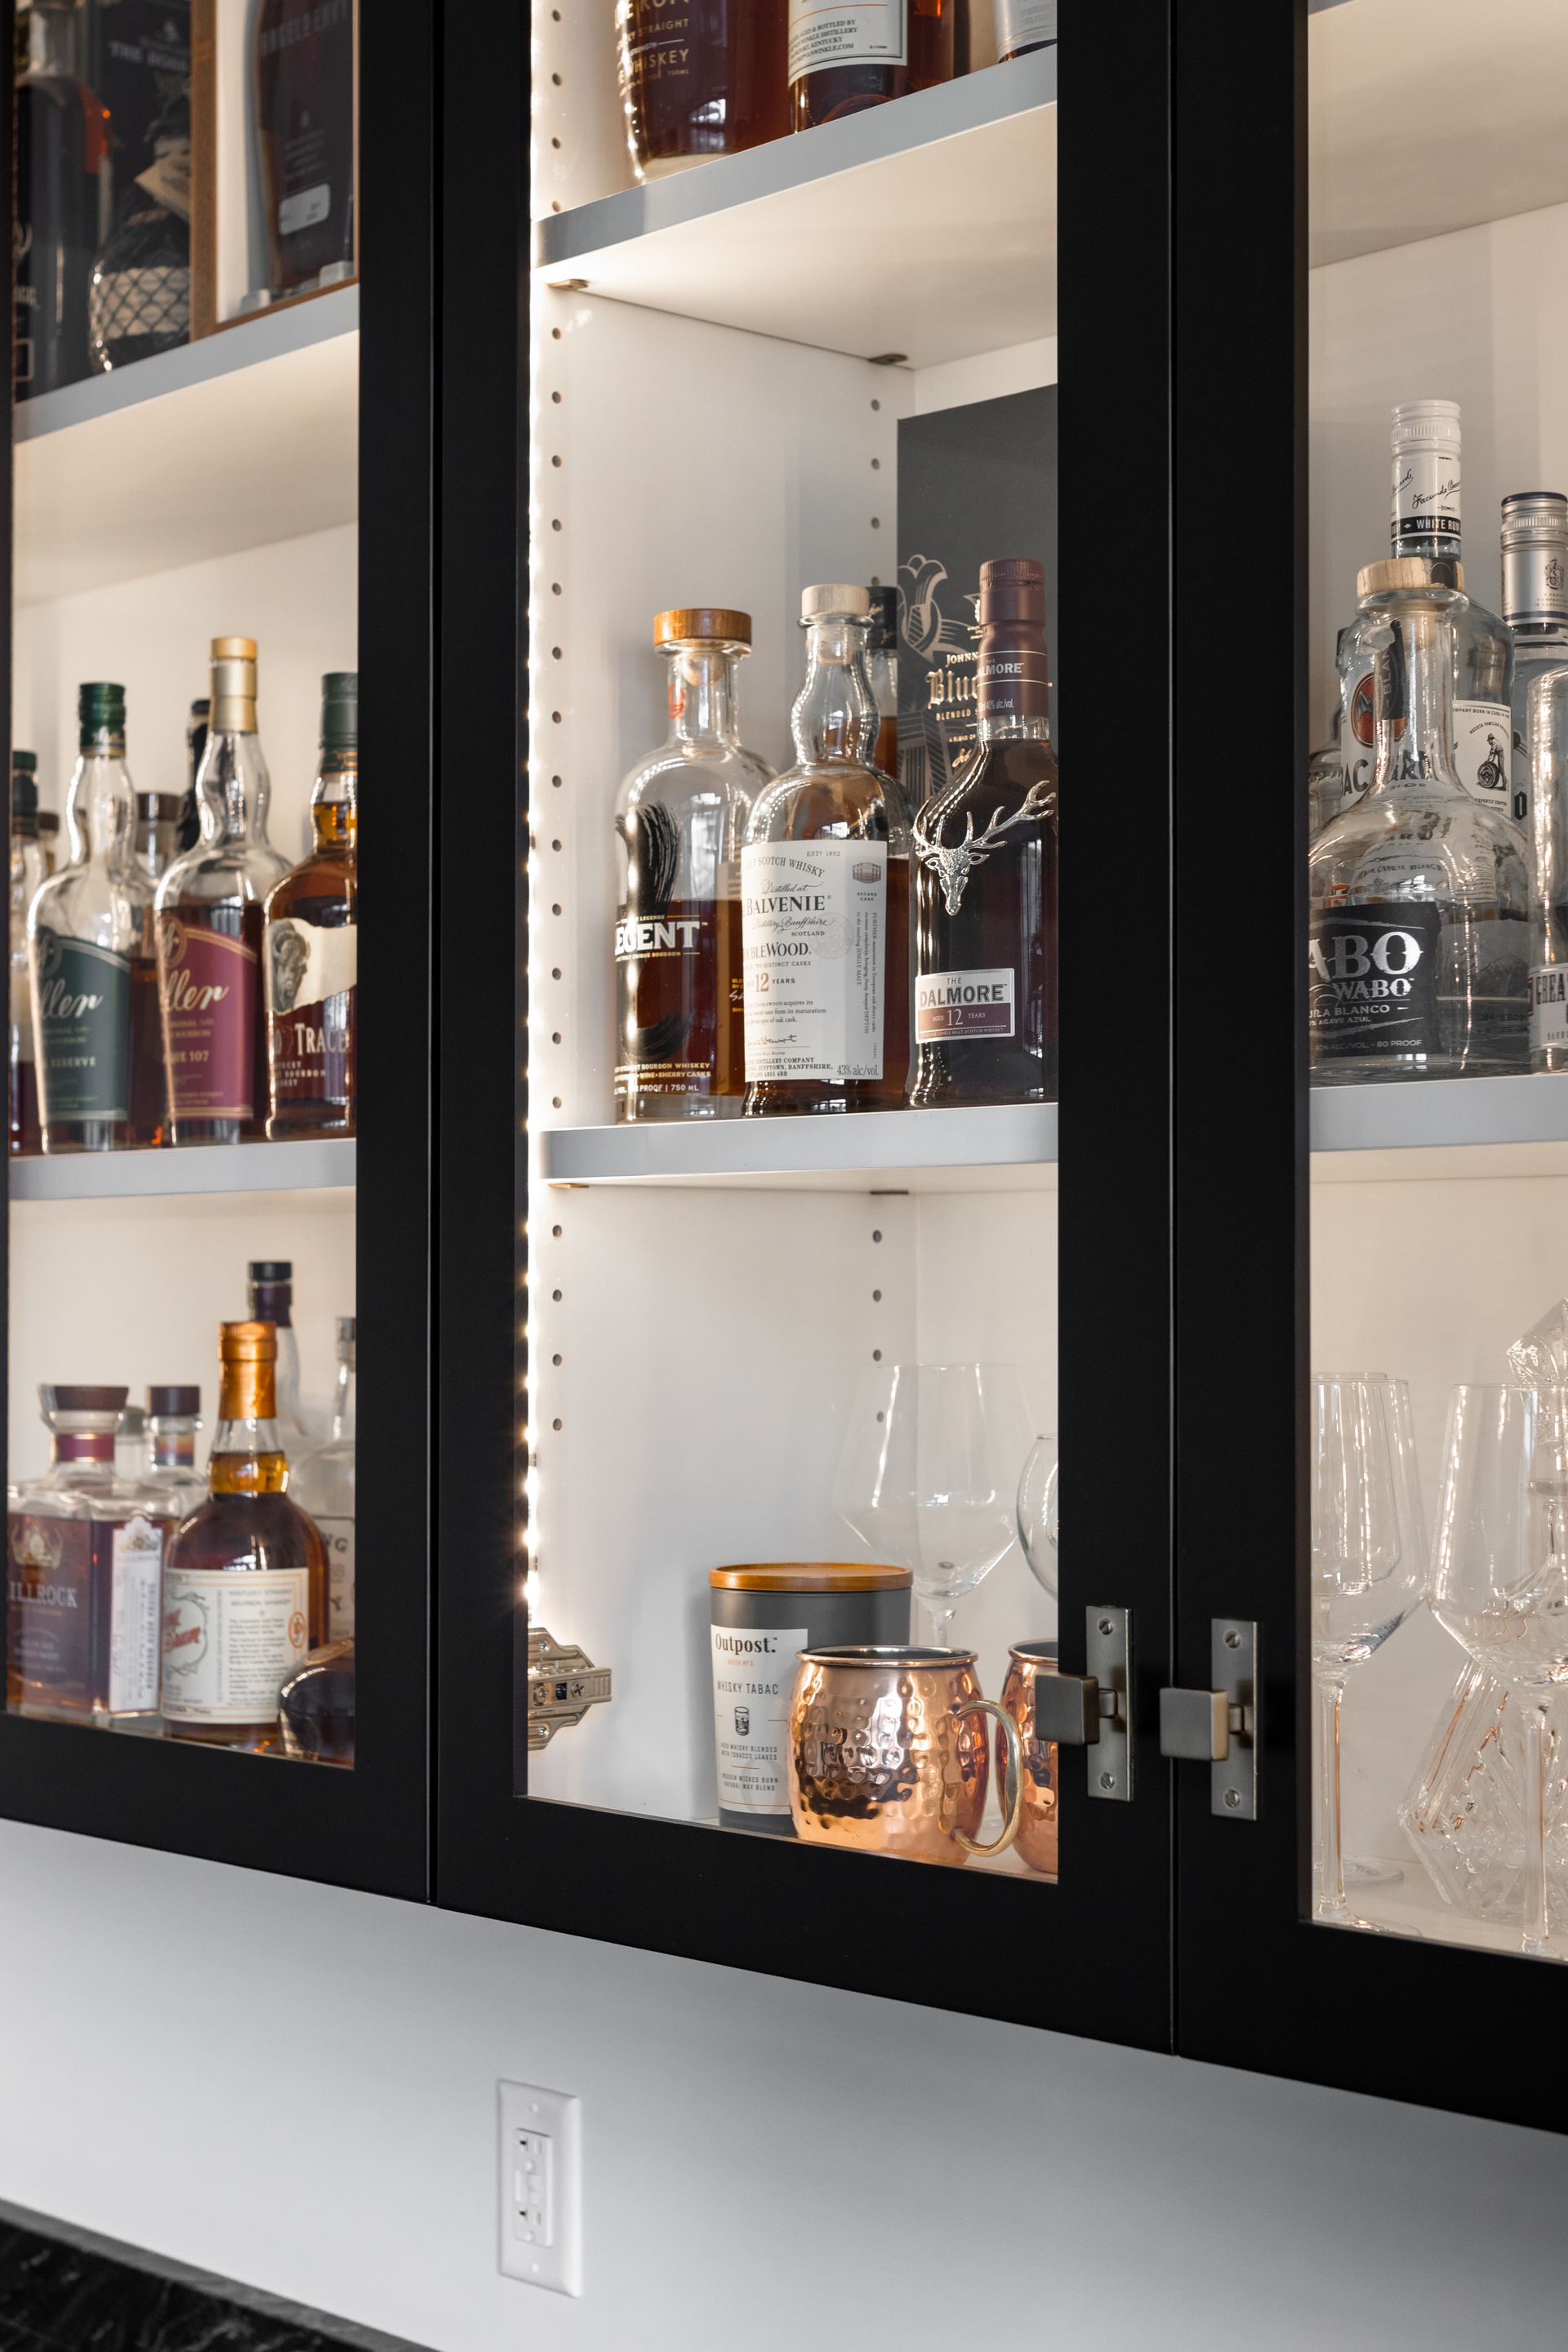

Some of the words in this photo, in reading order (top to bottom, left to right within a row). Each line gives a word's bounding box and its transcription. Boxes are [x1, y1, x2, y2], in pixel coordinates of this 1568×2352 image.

[817, 20, 846, 30] BOTTLED
[820, 26, 859, 38] DISTILLERY
[811, 37, 844, 47] KENTUCKY
[1416, 518, 1446, 529] WHITE
[936, 708, 971, 721] BLENDED
[759, 857, 786, 866] SCOTCH
[789, 858, 825, 878] WHISKY
[746, 895, 826, 915] BALVENIE
[755, 973, 769, 992] 12
[947, 977, 962, 985] THE
[920, 983, 1004, 1007] DALMORE
[1332, 978, 1413, 1001] WABO
[783, 999, 805, 1007] acquires
[1334, 1004, 1390, 1017] BLANCO
[947, 1009, 964, 1026] 12
[968, 1012, 987, 1020] YEARS
[1318, 1018, 1345, 1026] AGAVE
[1348, 1015, 1372, 1023] AZUL
[294, 1022, 349, 1056] TRACE
[1390, 1039, 1423, 1047] PROOF
[189, 1050, 209, 1062] 107
[836, 1064, 852, 1076] 43%
[852, 1064, 880, 1076] alc/vol.
[639, 1084, 663, 1093] PROOF
[670, 1084, 686, 1092] 750
[715, 1633, 777, 1655] Outpost.
[717, 1680, 742, 1695] WHISKY
[746, 1682, 779, 1695] TABAC
